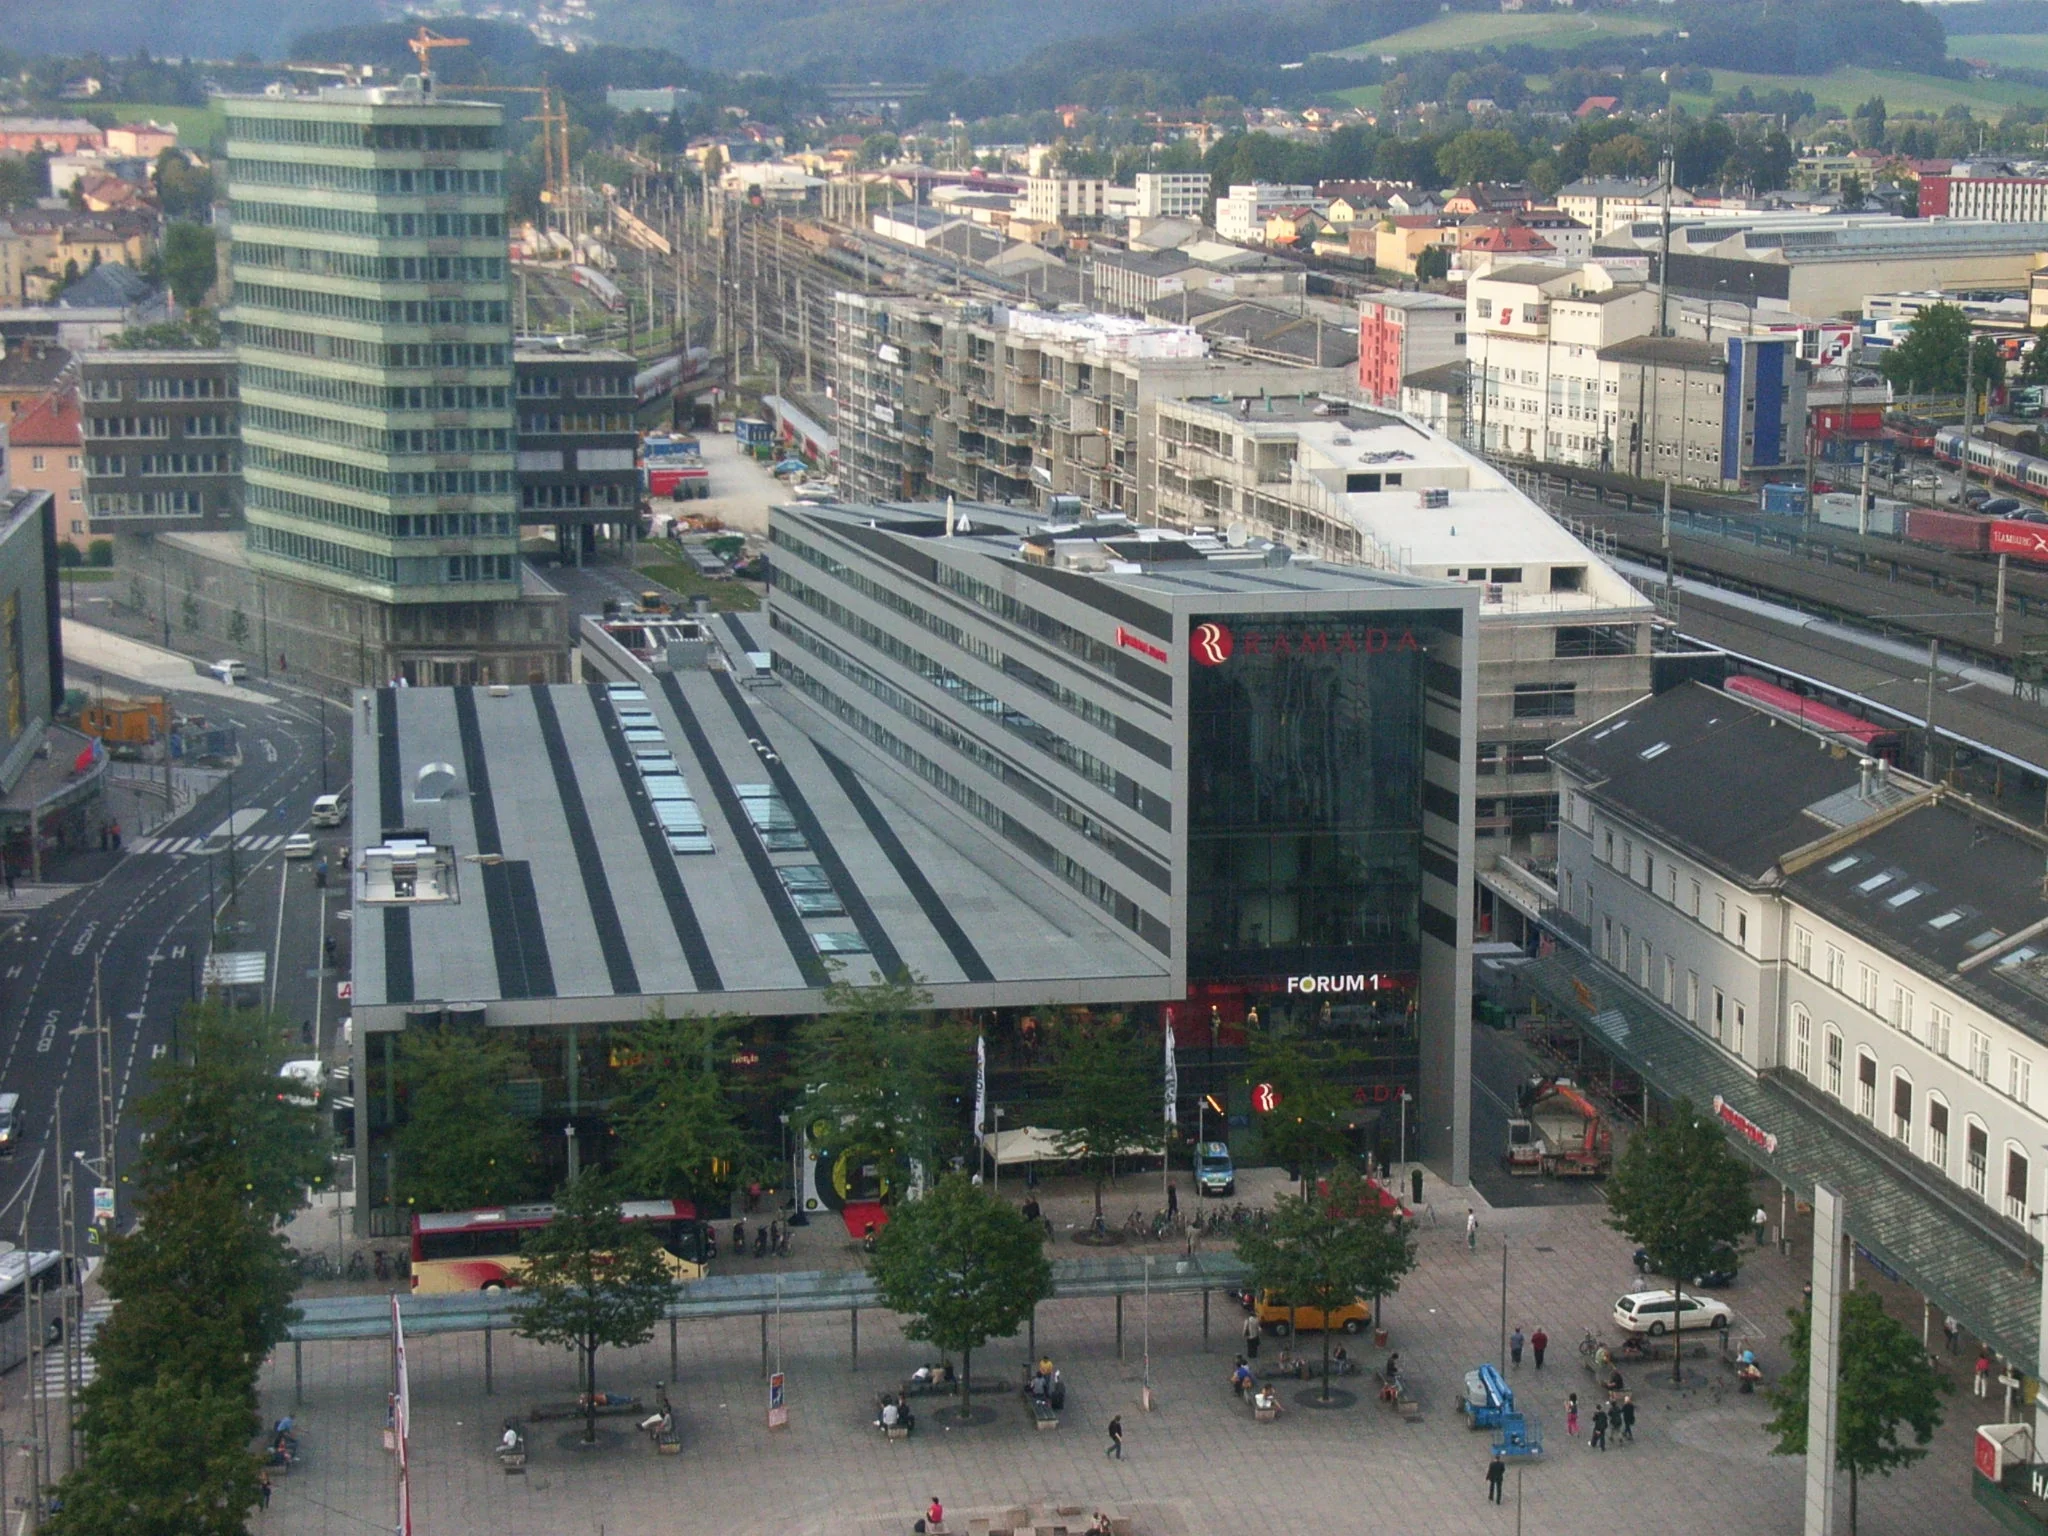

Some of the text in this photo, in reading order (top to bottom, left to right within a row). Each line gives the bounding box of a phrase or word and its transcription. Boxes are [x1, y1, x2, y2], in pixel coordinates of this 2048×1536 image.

[1244, 627, 1419, 656] RAMADA
[172, 946, 186, 959] H
[1287, 973, 1379, 994] FORUM 1
